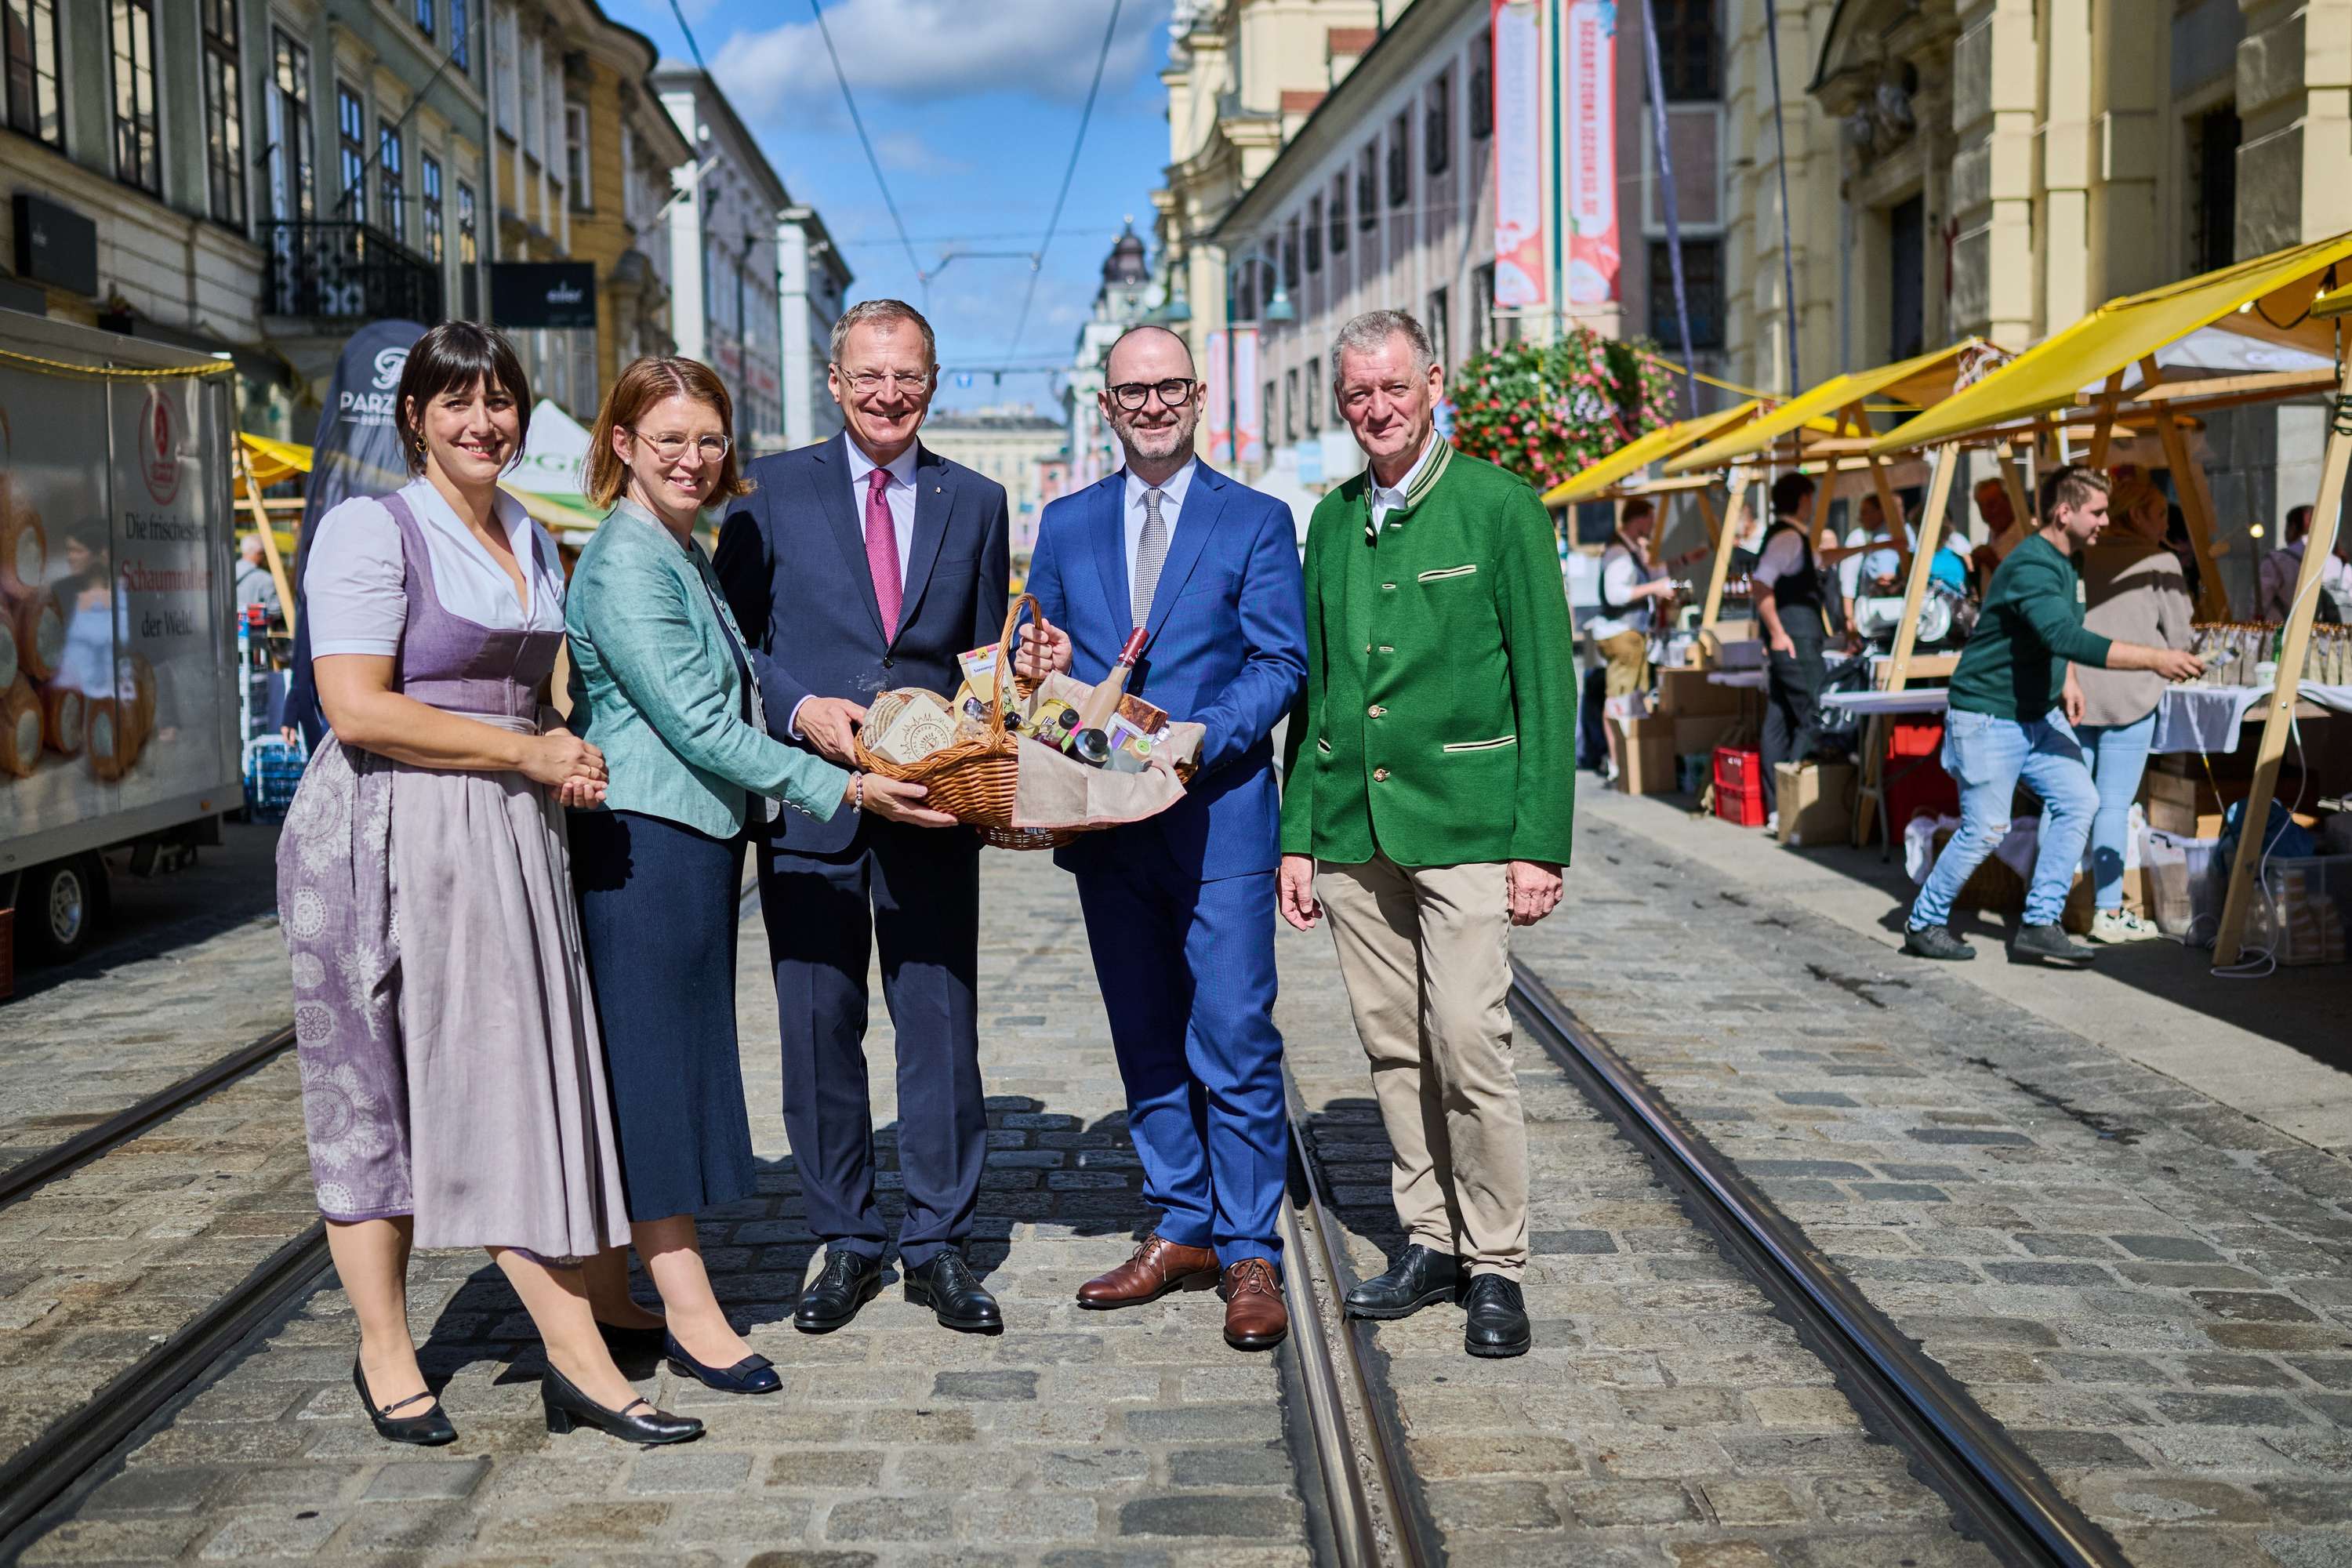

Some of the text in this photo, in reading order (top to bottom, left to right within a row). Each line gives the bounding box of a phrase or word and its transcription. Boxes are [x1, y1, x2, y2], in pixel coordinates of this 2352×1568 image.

[339, 391, 396, 414] PARZ
[125, 512, 209, 541] Die frischesten
[122, 558, 213, 592] Schaumrollen
[141, 611, 162, 637] der
